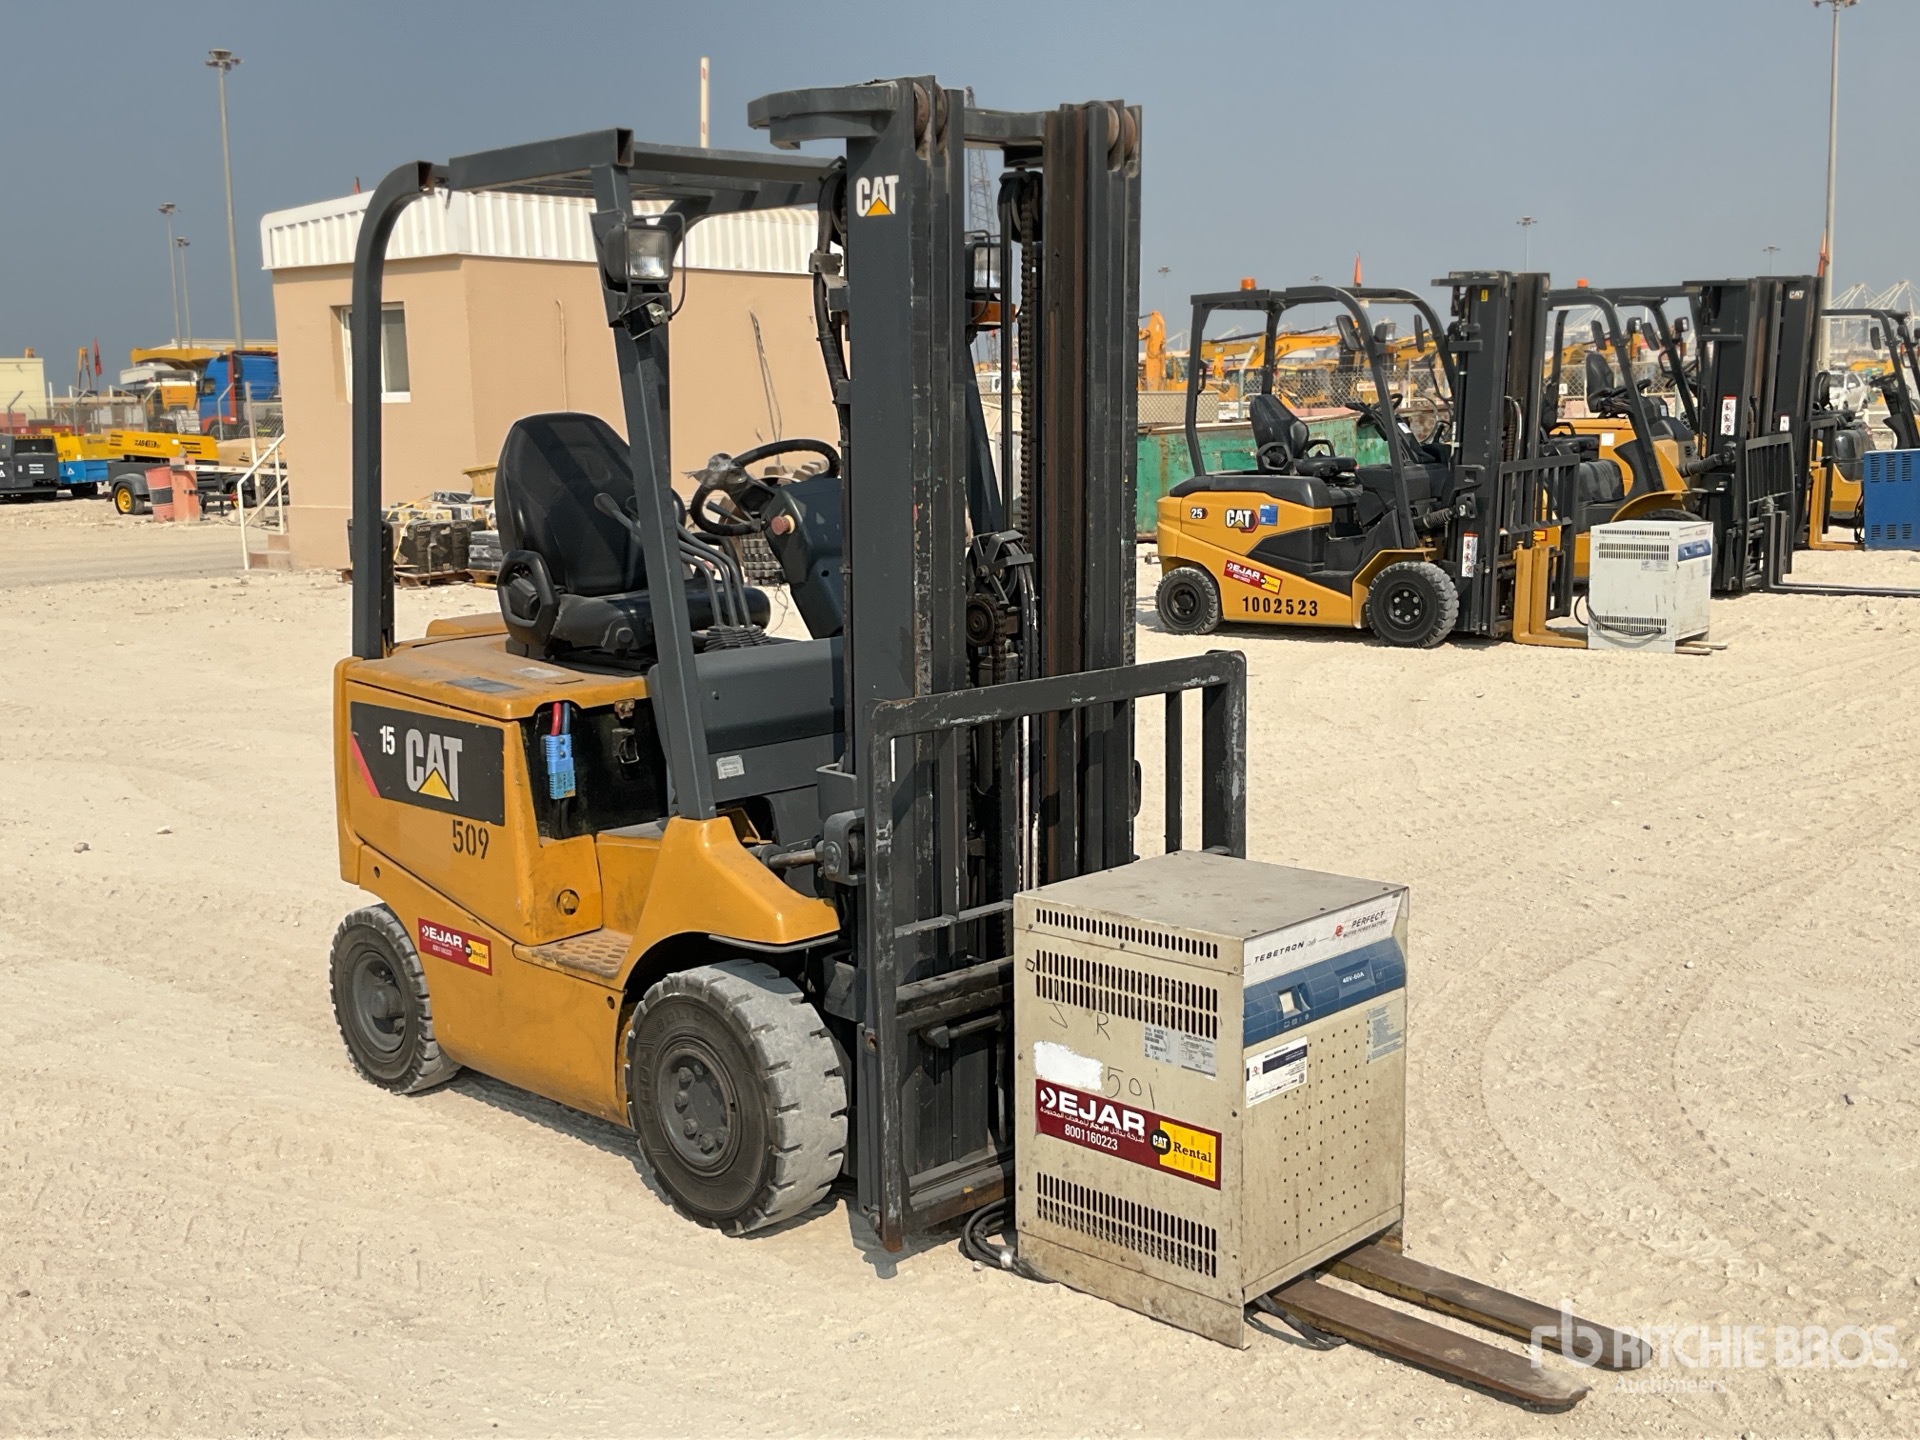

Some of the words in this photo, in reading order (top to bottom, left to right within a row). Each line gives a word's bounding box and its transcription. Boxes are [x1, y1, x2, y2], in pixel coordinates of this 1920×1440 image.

[856, 175, 900, 217] CAT
[1191, 508, 1203, 519] 25
[1226, 509, 1252, 528] CAT
[1242, 595, 1318, 617] 1002523
[379, 725, 396, 755] 15
[405, 728, 463, 802] CAT
[452, 820, 490, 860] 509
[1351, 911, 1385, 928] PERFECT
[1254, 941, 1305, 963] TEBETRON
[1065, 1124, 1118, 1151] 8001160223
[1152, 1134, 1168, 1150] CAT
[1173, 1142, 1212, 1163] Rental
